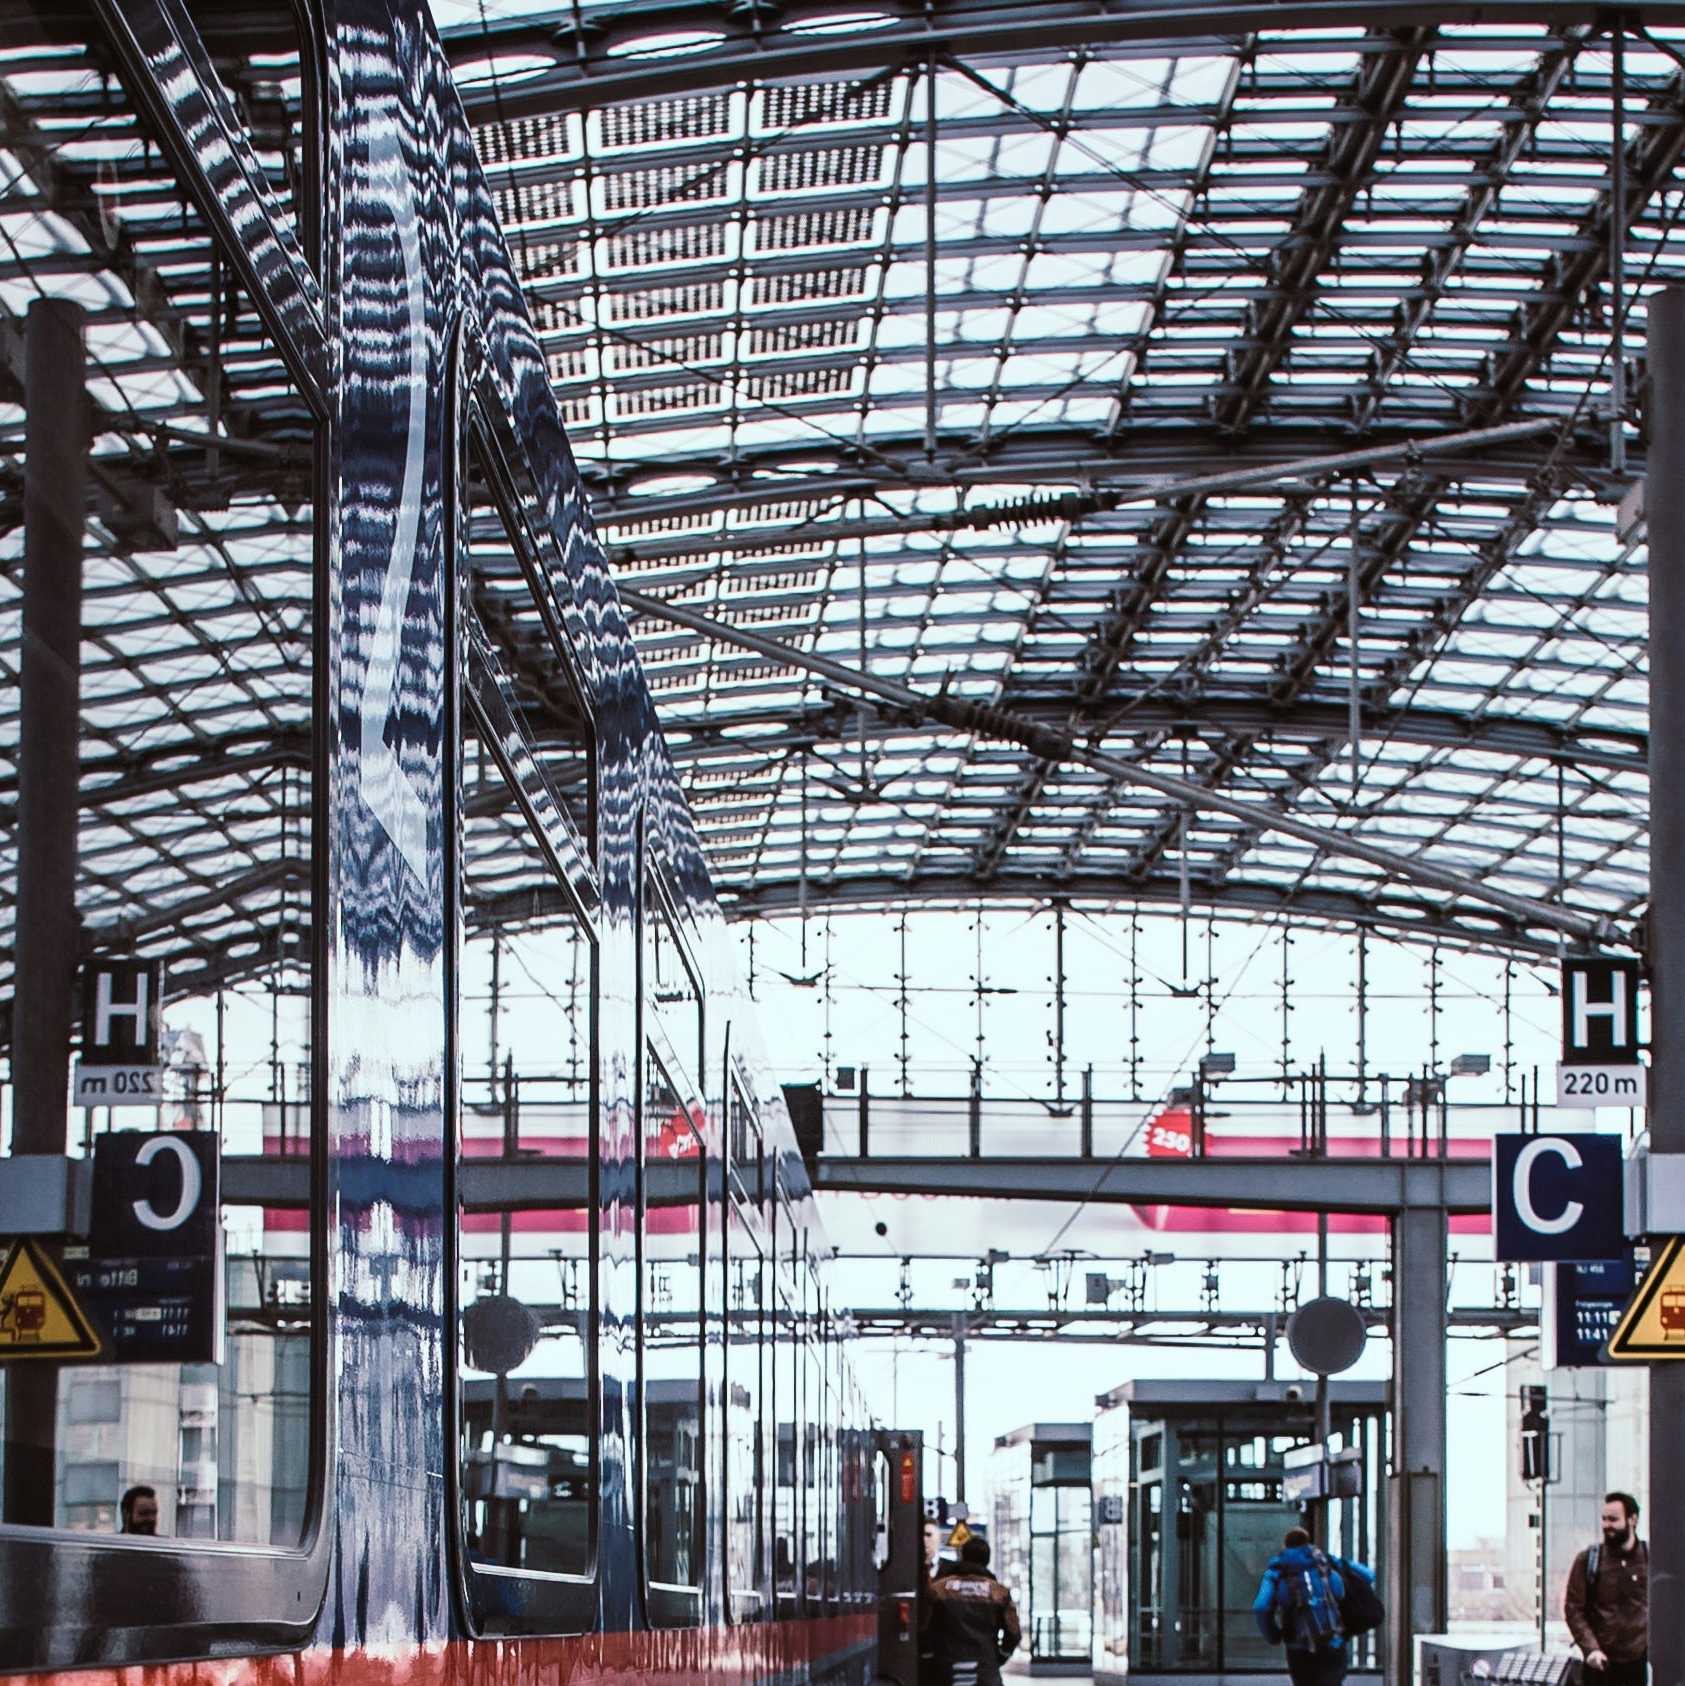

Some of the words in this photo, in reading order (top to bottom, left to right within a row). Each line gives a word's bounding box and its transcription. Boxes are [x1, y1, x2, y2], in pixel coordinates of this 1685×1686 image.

[1572, 970, 1627, 1048] H
[1564, 1072, 1609, 1095] 220
[1615, 1078, 1637, 1094] m
[1152, 1126, 1191, 1153] 250
[1512, 1136, 1584, 1234] C
